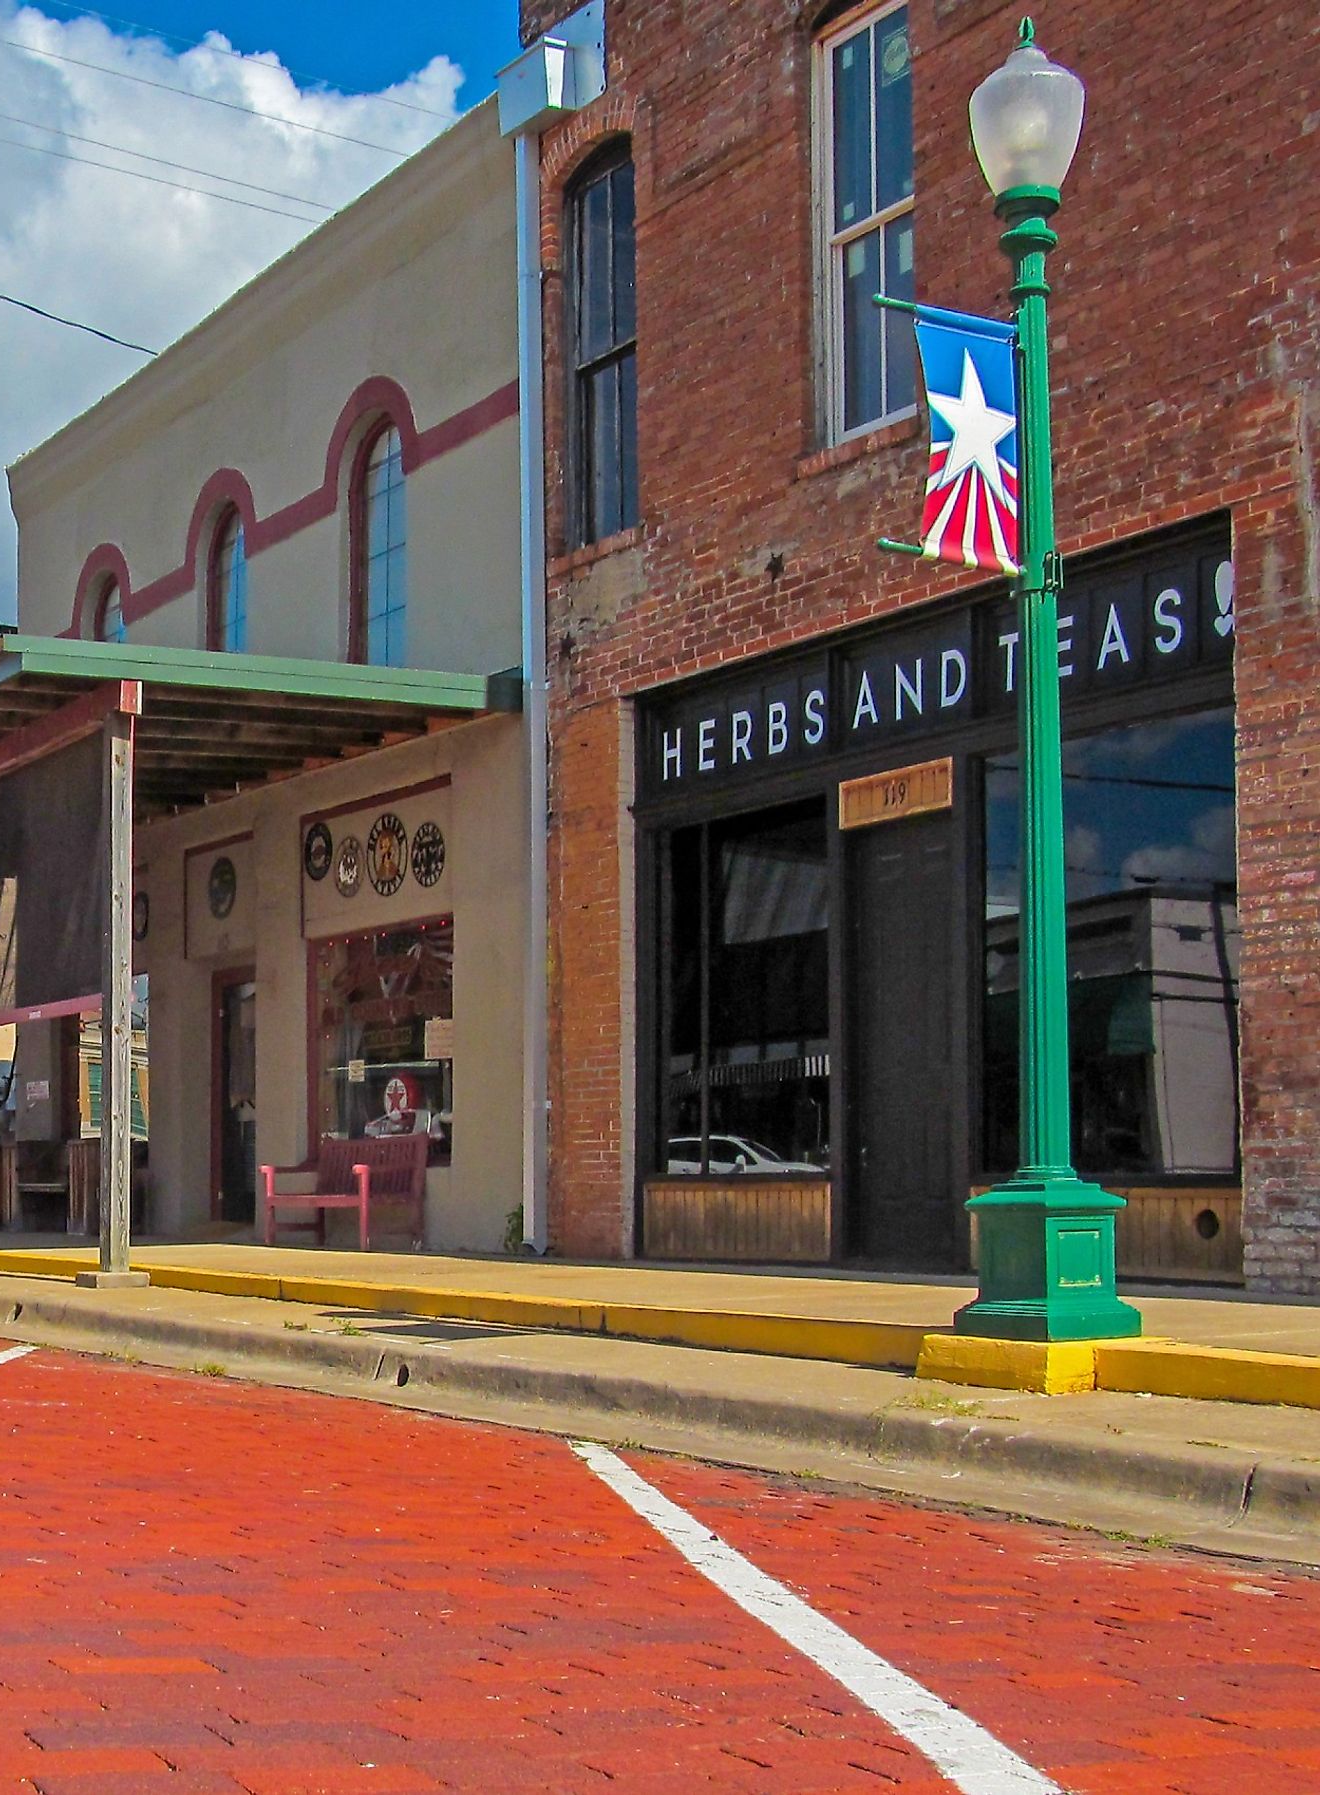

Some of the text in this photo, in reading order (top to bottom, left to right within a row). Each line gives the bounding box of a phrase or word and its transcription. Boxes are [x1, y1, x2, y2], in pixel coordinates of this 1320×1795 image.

[663, 689, 826, 781] HERBS
[853, 648, 967, 729] AND
[884, 782, 906, 806] 119
